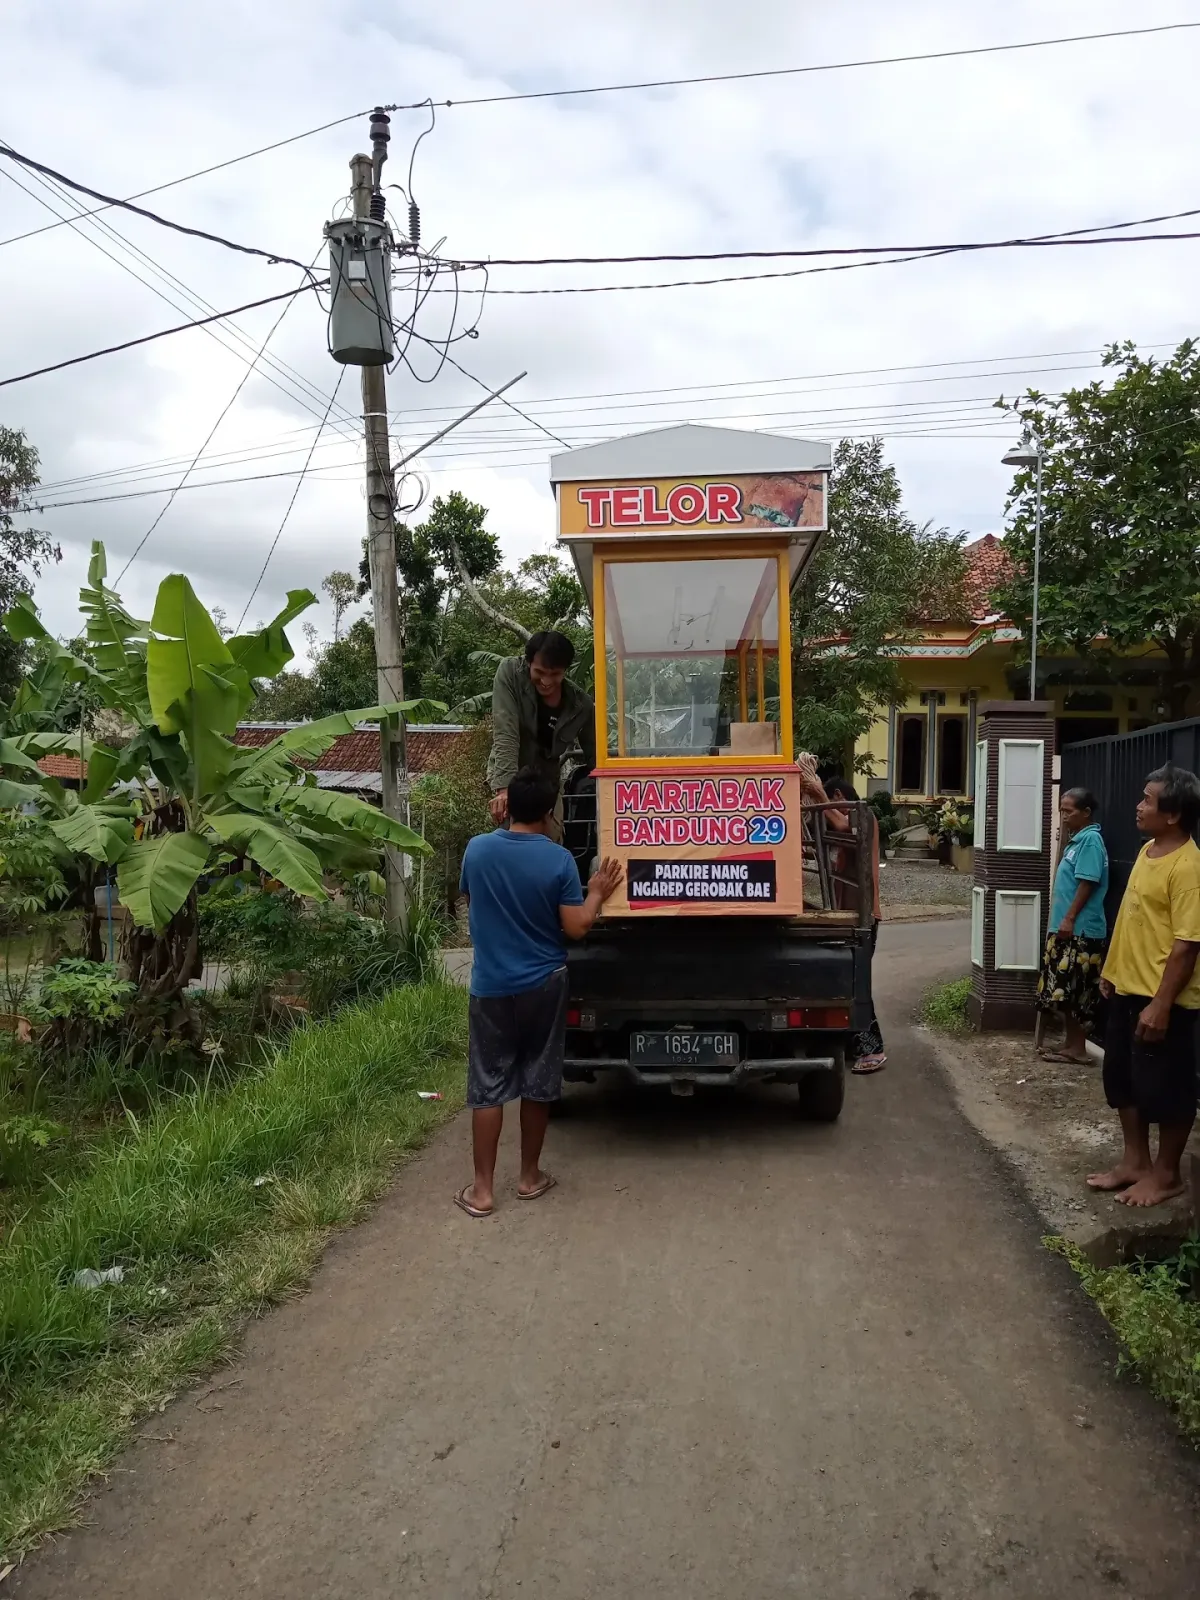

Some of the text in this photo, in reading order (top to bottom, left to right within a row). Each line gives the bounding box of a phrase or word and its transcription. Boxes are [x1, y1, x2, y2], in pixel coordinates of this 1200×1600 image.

[578, 483, 743, 527] TELOR
[615, 778, 785, 813] MARTABAK
[615, 815, 787, 846] BANDUNG 29
[655, 864, 748, 880] PARKIRE NANG
[632, 881, 771, 898] NGAREP GEROBAK BAE
[636, 1034, 733, 1054] R 1654 GH
